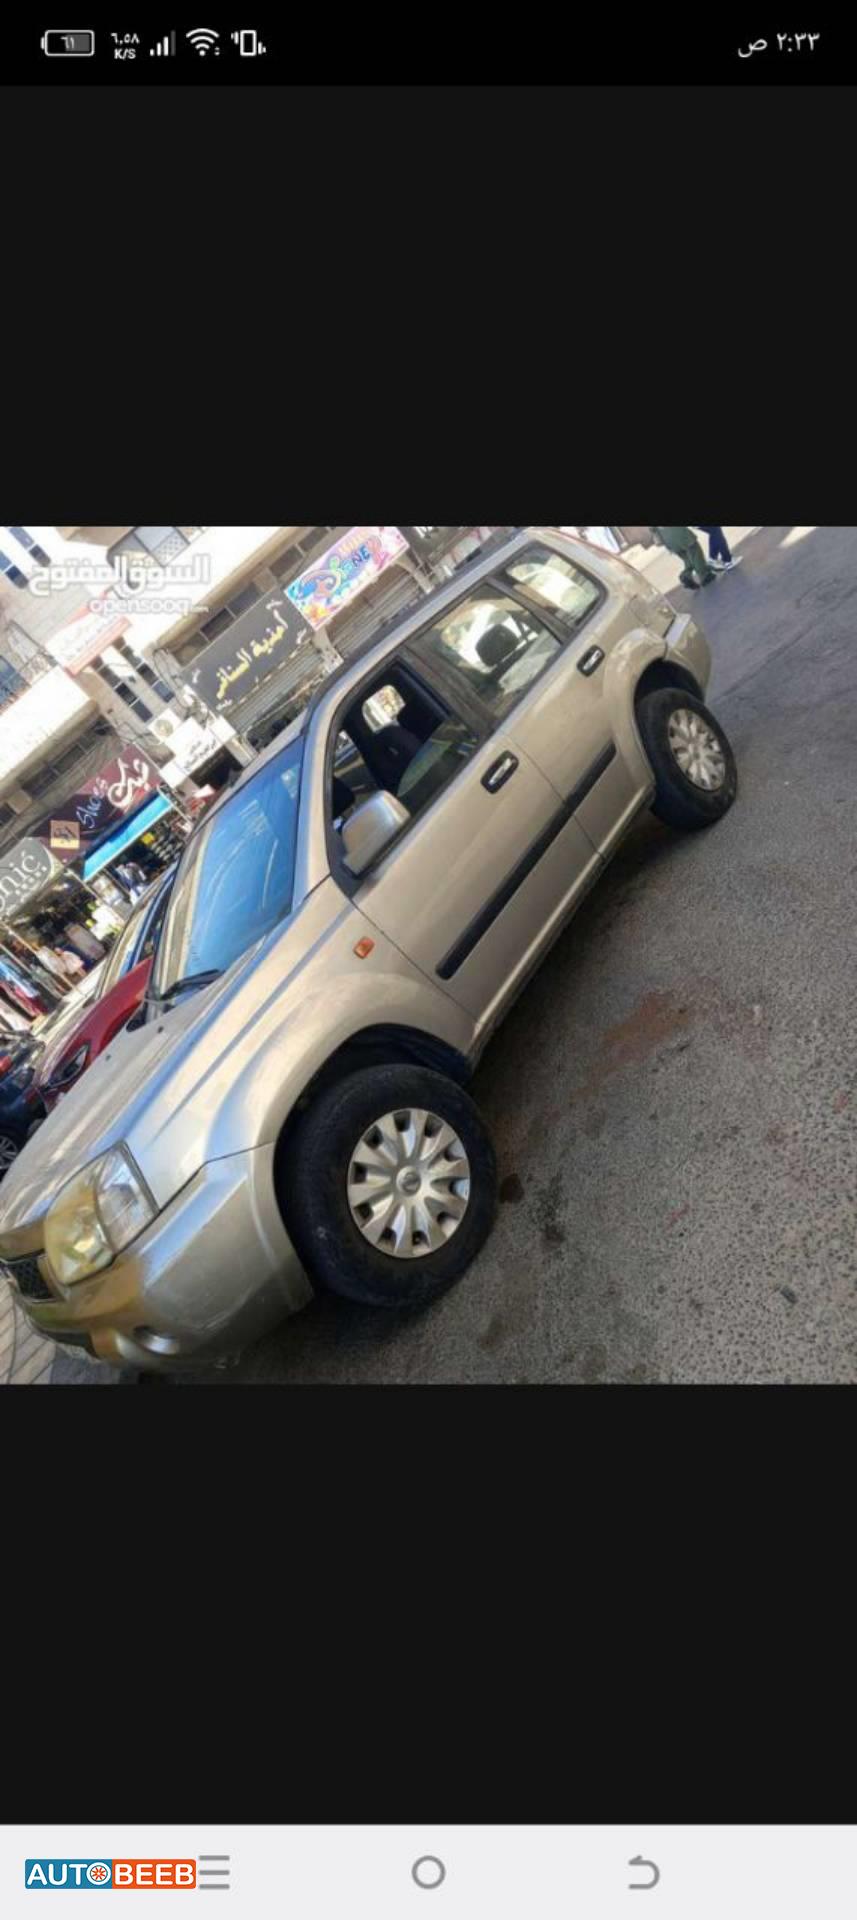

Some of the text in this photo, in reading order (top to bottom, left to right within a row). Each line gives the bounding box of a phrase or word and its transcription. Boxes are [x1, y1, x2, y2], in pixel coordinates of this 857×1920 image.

[114, 48, 136, 60] K/S
[737, 32, 820, 58] ٢:٣٣ ص
